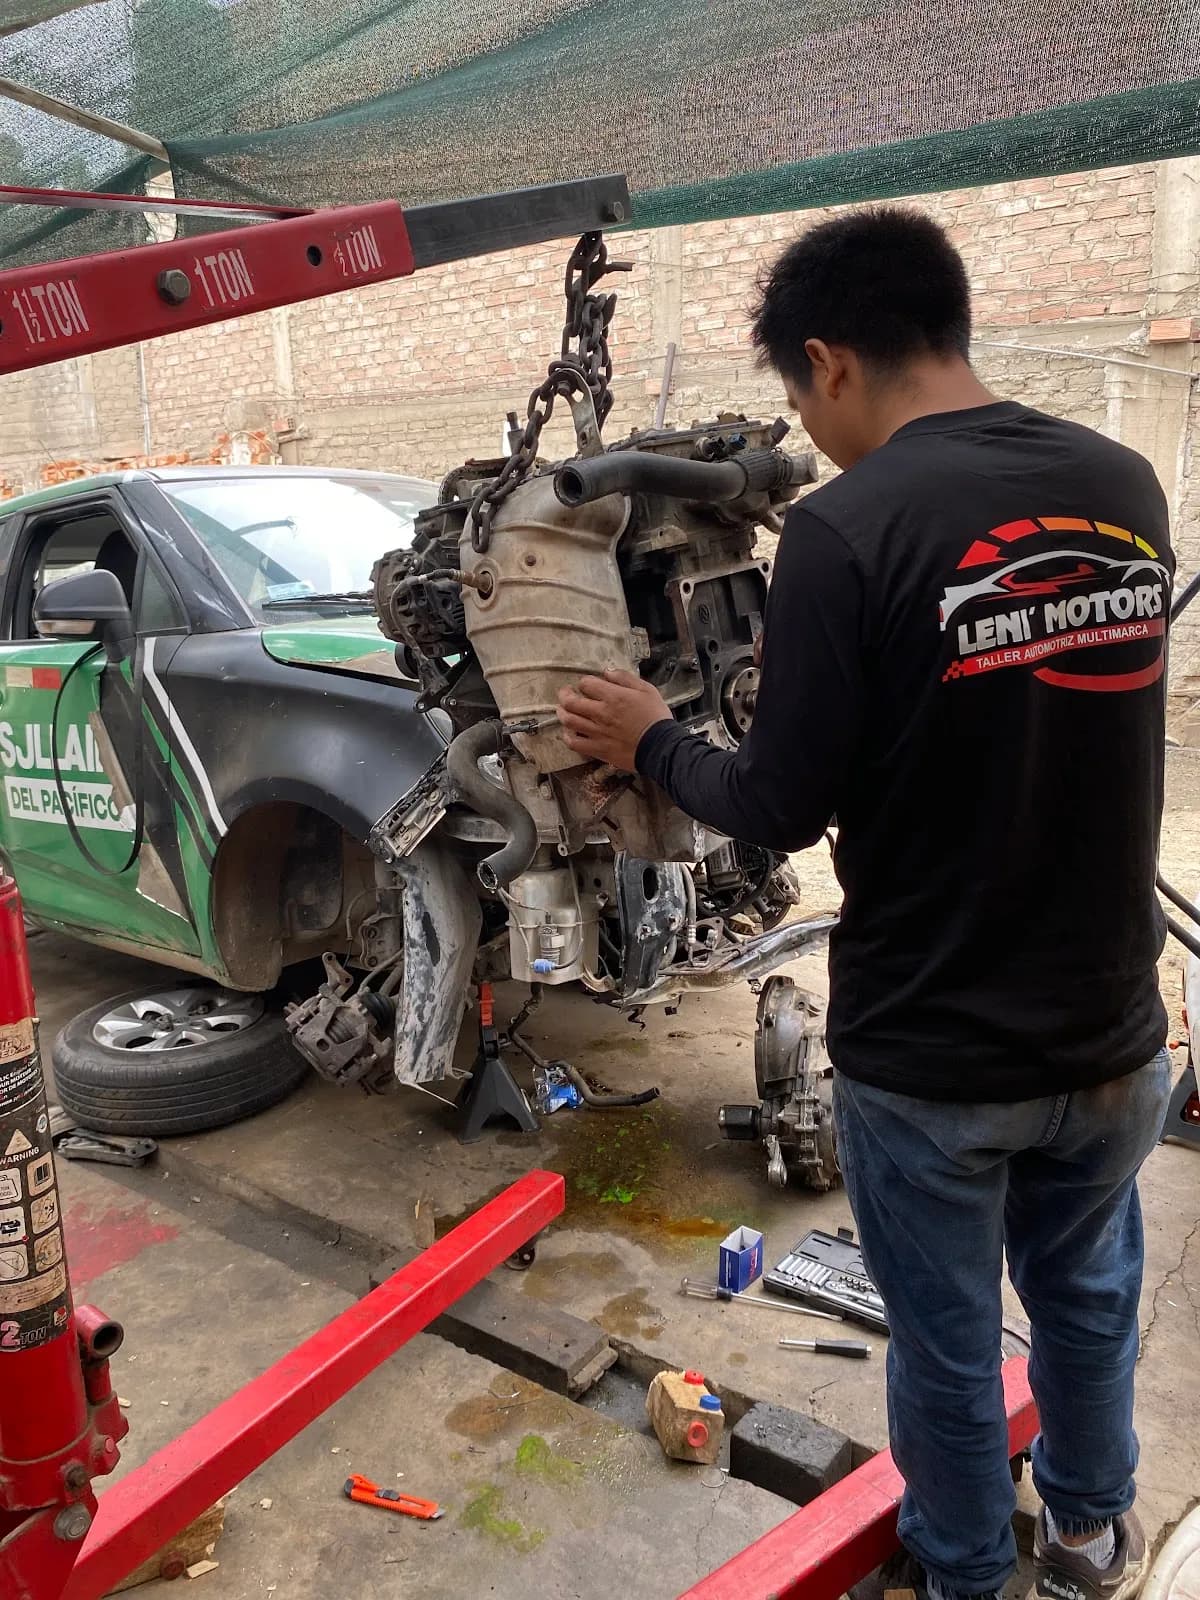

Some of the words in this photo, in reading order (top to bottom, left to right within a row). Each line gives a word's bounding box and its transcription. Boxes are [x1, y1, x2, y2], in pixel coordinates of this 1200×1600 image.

[1044, 583, 1163, 633] MOTORS
[976, 648, 1022, 669] TALLER
[1023, 635, 1075, 660] AUTOMOTRIZ
[1077, 624, 1149, 645] MULTIMARCA
[10, 786, 40, 813] DEL
[0, 1146, 40, 1165] WARNING
[0, 1320, 21, 1347] 2
[20, 1326, 47, 1345] TON
